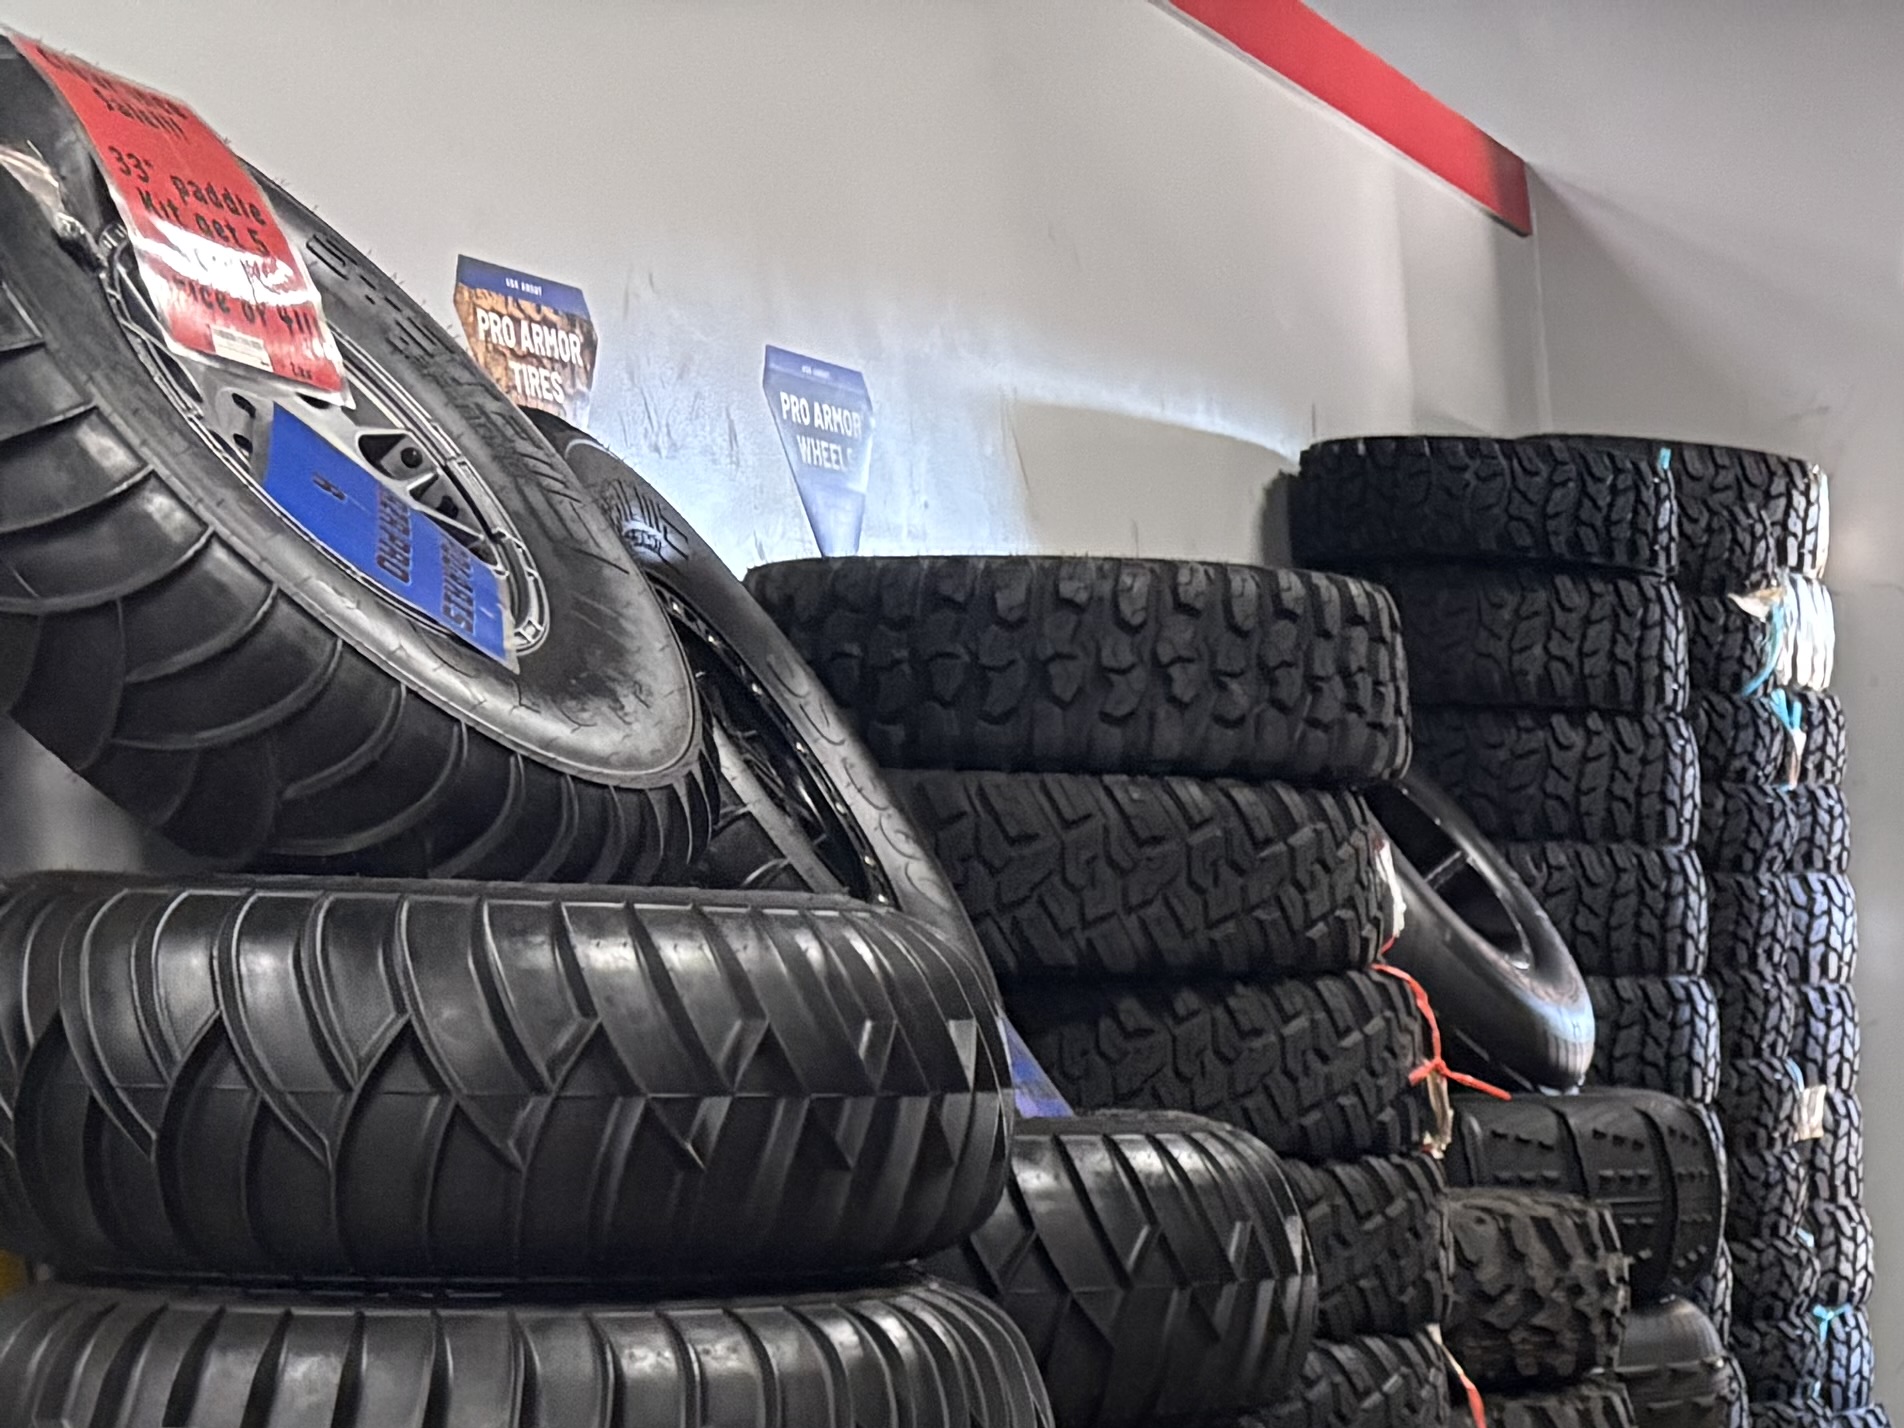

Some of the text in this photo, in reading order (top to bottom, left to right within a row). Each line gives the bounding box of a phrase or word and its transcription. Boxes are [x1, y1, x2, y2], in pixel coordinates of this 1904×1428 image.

[170, 175, 267, 226] paddle
[476, 308, 584, 367] PRO ARMOR
[508, 360, 566, 402] TIRES
[780, 391, 862, 439] PRO ARMOR
